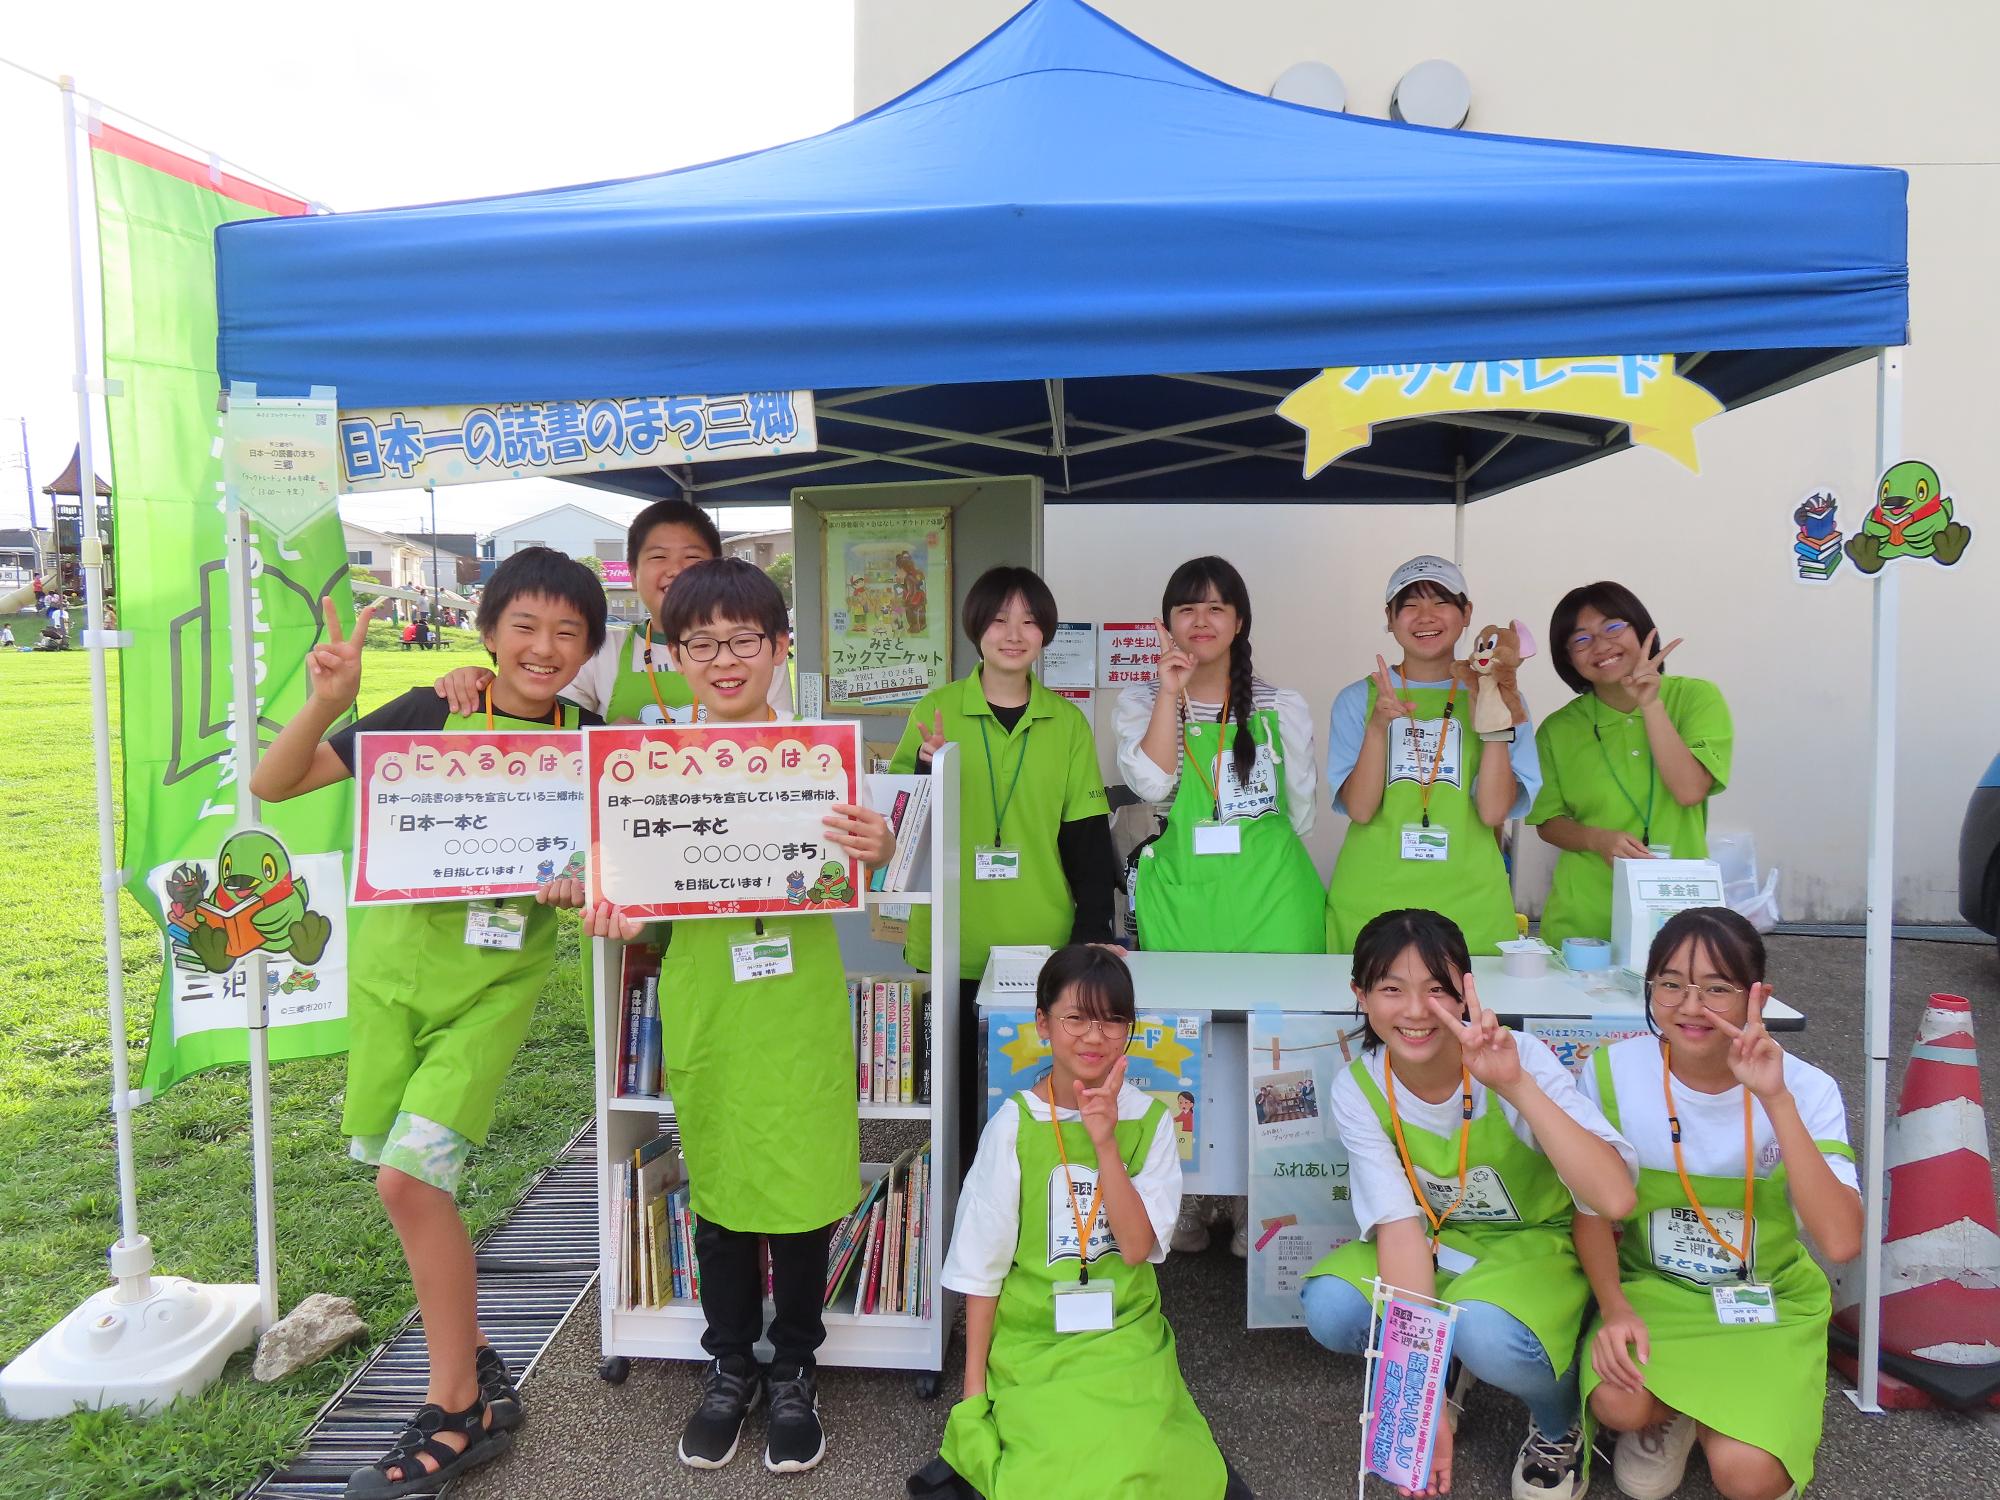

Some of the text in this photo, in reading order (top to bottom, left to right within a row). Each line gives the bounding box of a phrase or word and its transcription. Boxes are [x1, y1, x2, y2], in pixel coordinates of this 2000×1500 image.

[341, 390, 797, 481] 日本一の読書のまち三郷
[249, 449, 316, 457] 日本一の読書のまち
[869, 638, 904, 650] みさと
[1112, 636, 1160, 648] 小学生以
[607, 789, 840, 808] 日本一の読書のまちを宣言している三郷市は、
[389, 814, 488, 832] 「日本一本と
[623, 817, 729, 838] 「日本一本と
[1657, 884, 1700, 897] 募金箱
[1331, 1185, 1352, 1201] 養
[1371, 1360, 1404, 1473] 心豊かな生活を
[1394, 1351, 1429, 1469] 読書をとおして
